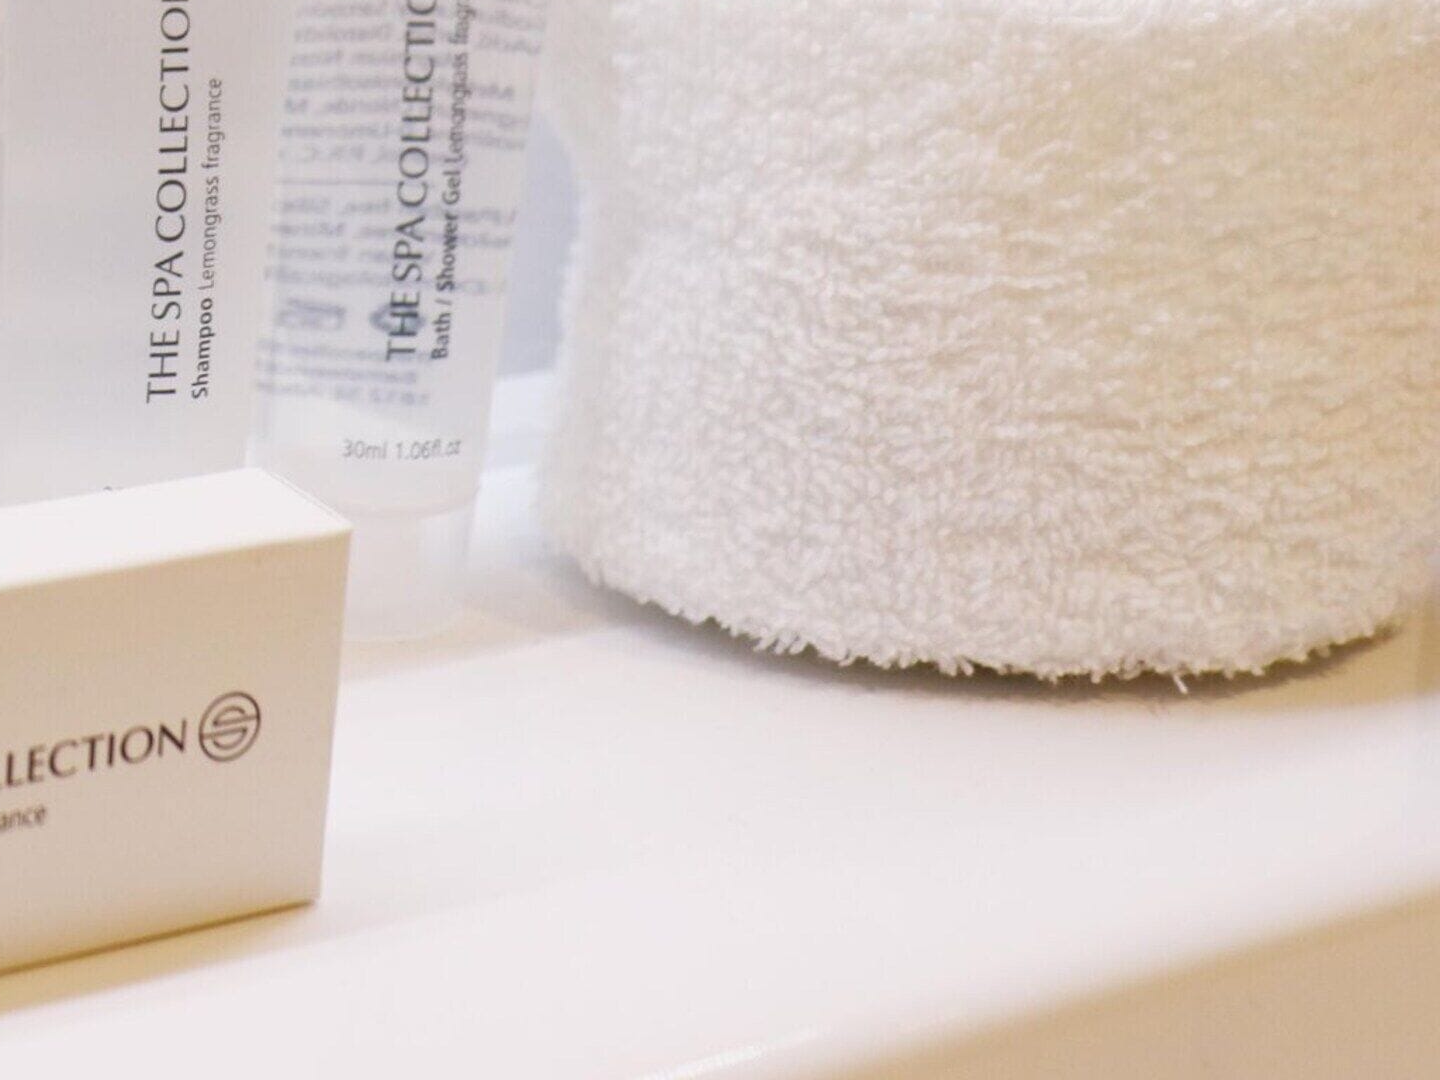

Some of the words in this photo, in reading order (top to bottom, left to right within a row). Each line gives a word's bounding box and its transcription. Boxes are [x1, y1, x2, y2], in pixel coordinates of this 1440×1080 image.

[200, 76, 226, 170] fragrance
[442, 169, 461, 206] Gel
[197, 174, 223, 291] Lemongrass
[391, 215, 425, 283] SPA
[435, 213, 459, 293] Shower
[151, 250, 185, 321] SPA
[190, 296, 217, 401] Shampoo
[386, 291, 421, 361] THE
[430, 311, 452, 360] Bath
[145, 329, 180, 405] THE
